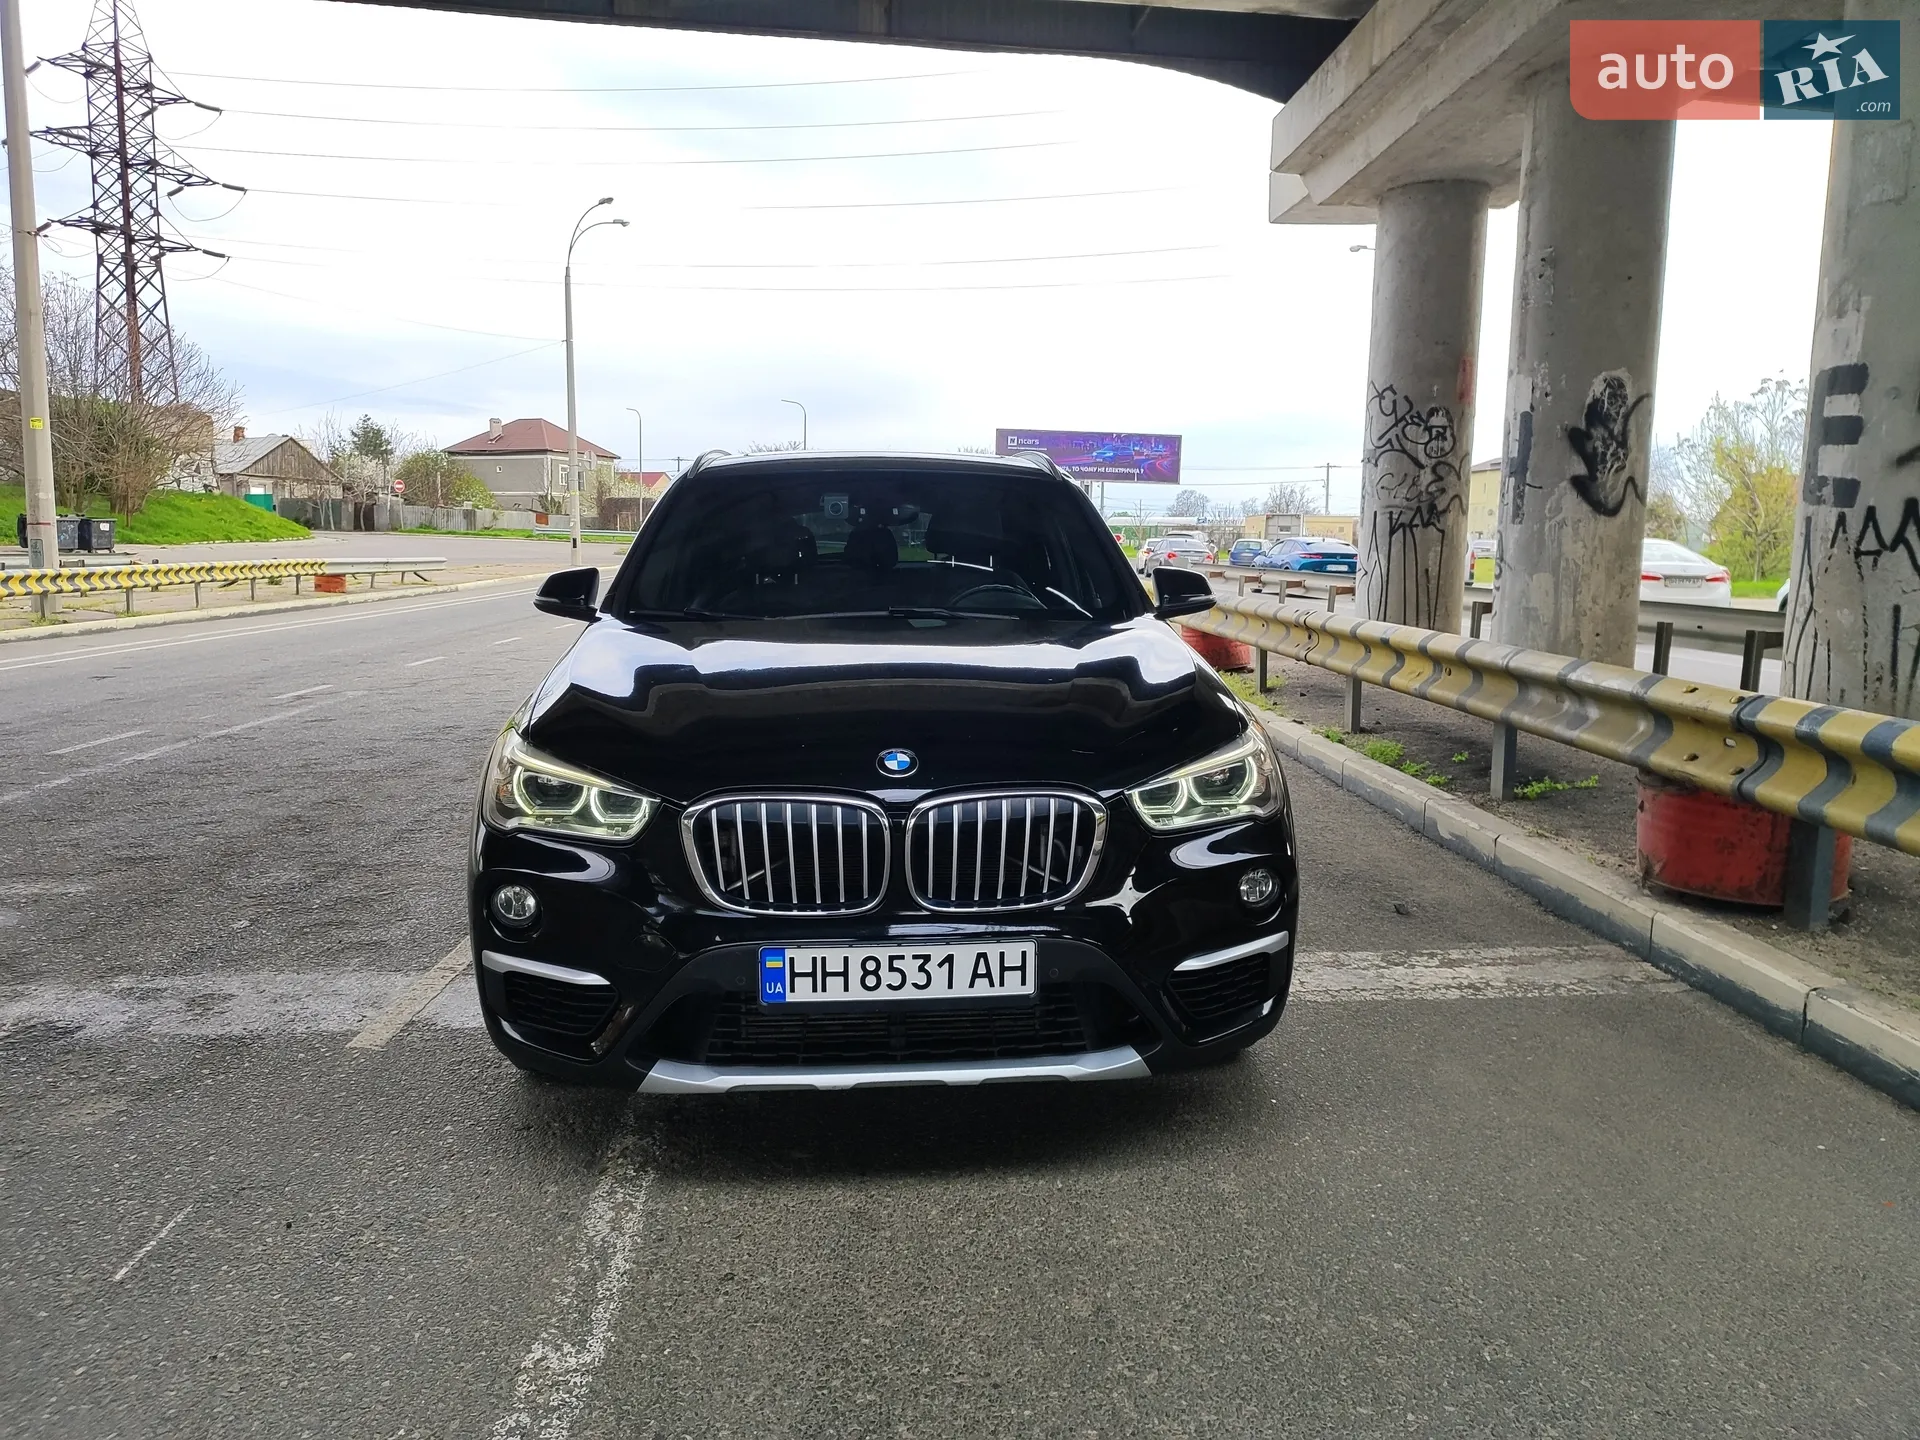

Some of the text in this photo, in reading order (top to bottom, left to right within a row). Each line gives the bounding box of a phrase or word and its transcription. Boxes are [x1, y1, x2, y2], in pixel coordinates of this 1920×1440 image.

[789, 950, 1027, 993] HH 8531 AH
[766, 982, 784, 994] UA
